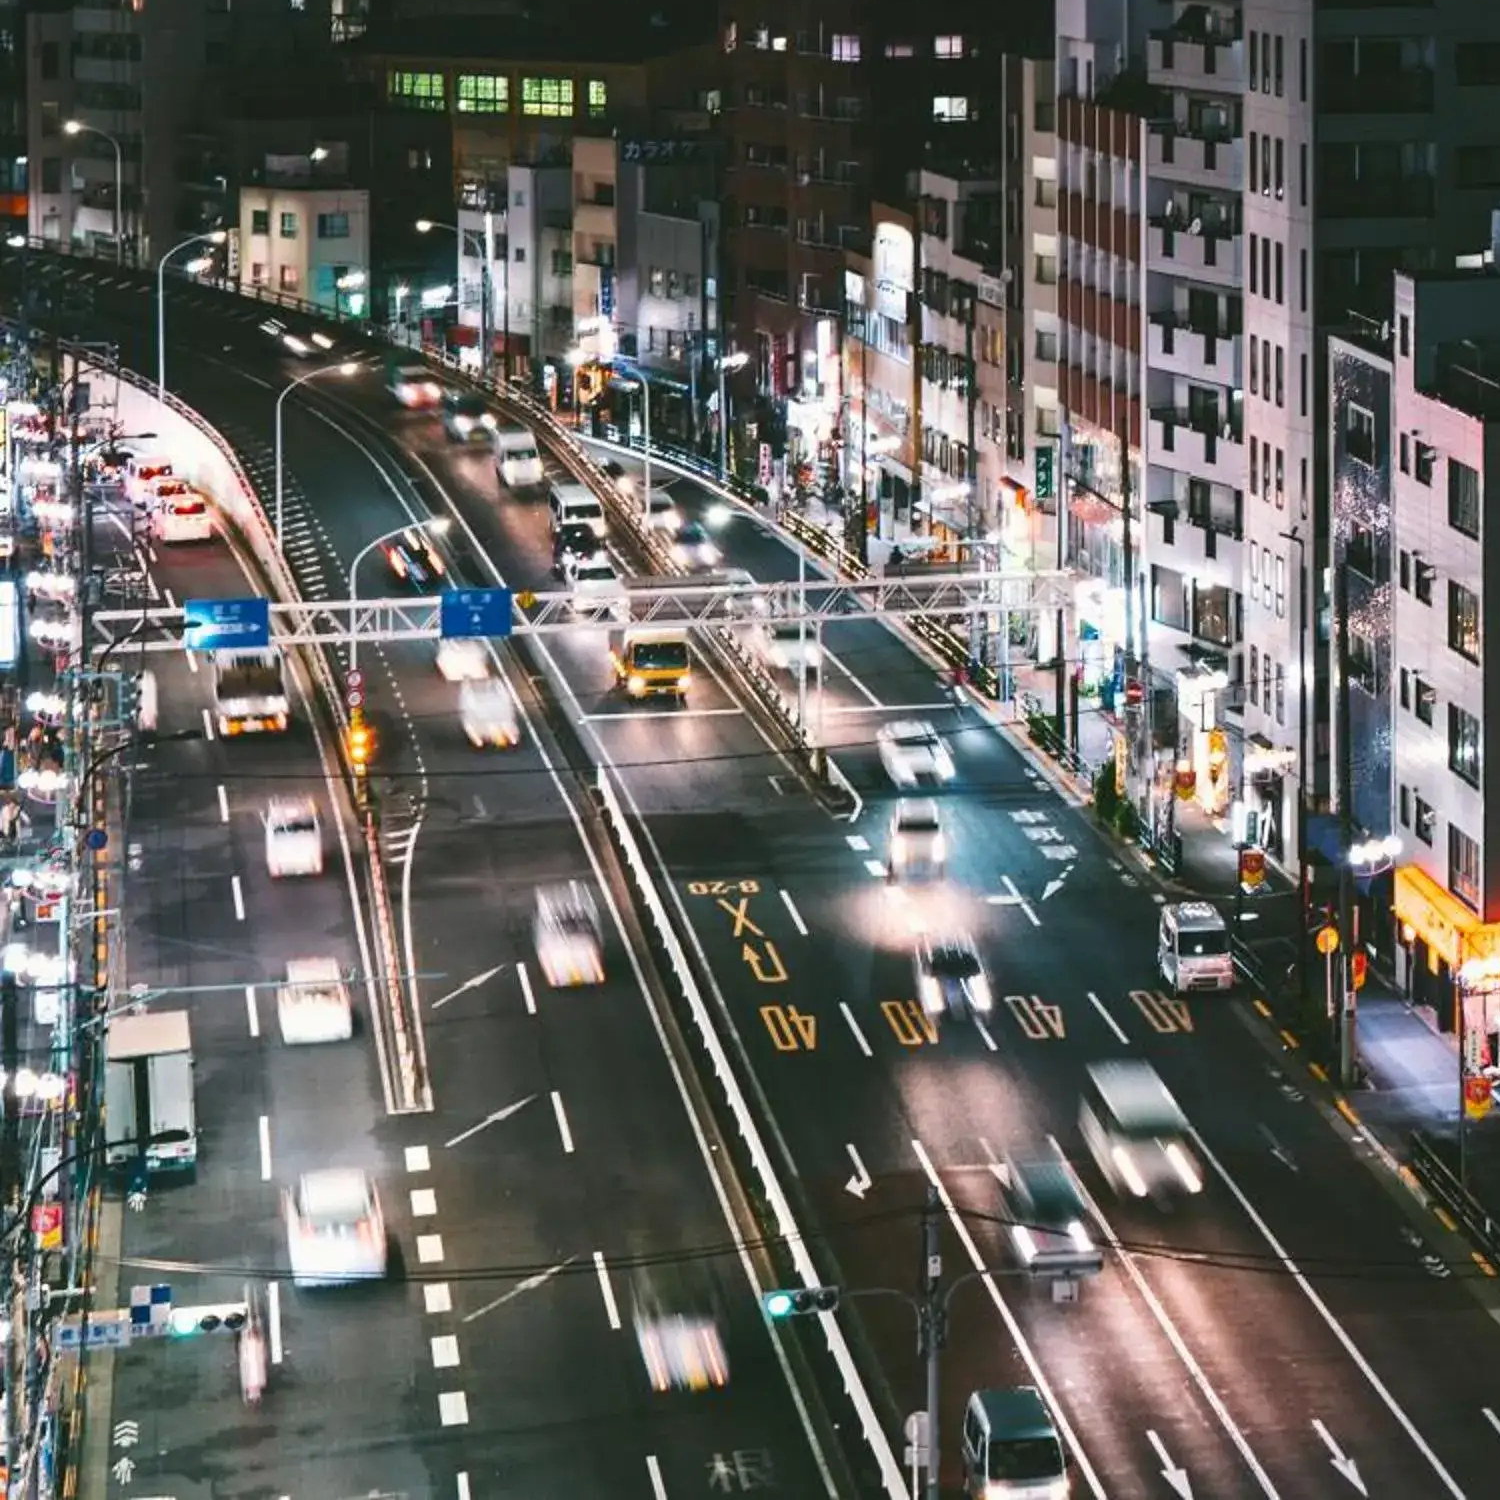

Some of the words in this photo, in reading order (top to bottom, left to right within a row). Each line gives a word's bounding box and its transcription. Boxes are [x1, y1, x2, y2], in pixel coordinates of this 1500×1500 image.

[759, 1004, 817, 1051] 40
[1003, 995, 1066, 1039] 40
[1129, 990, 1194, 1033] 40
